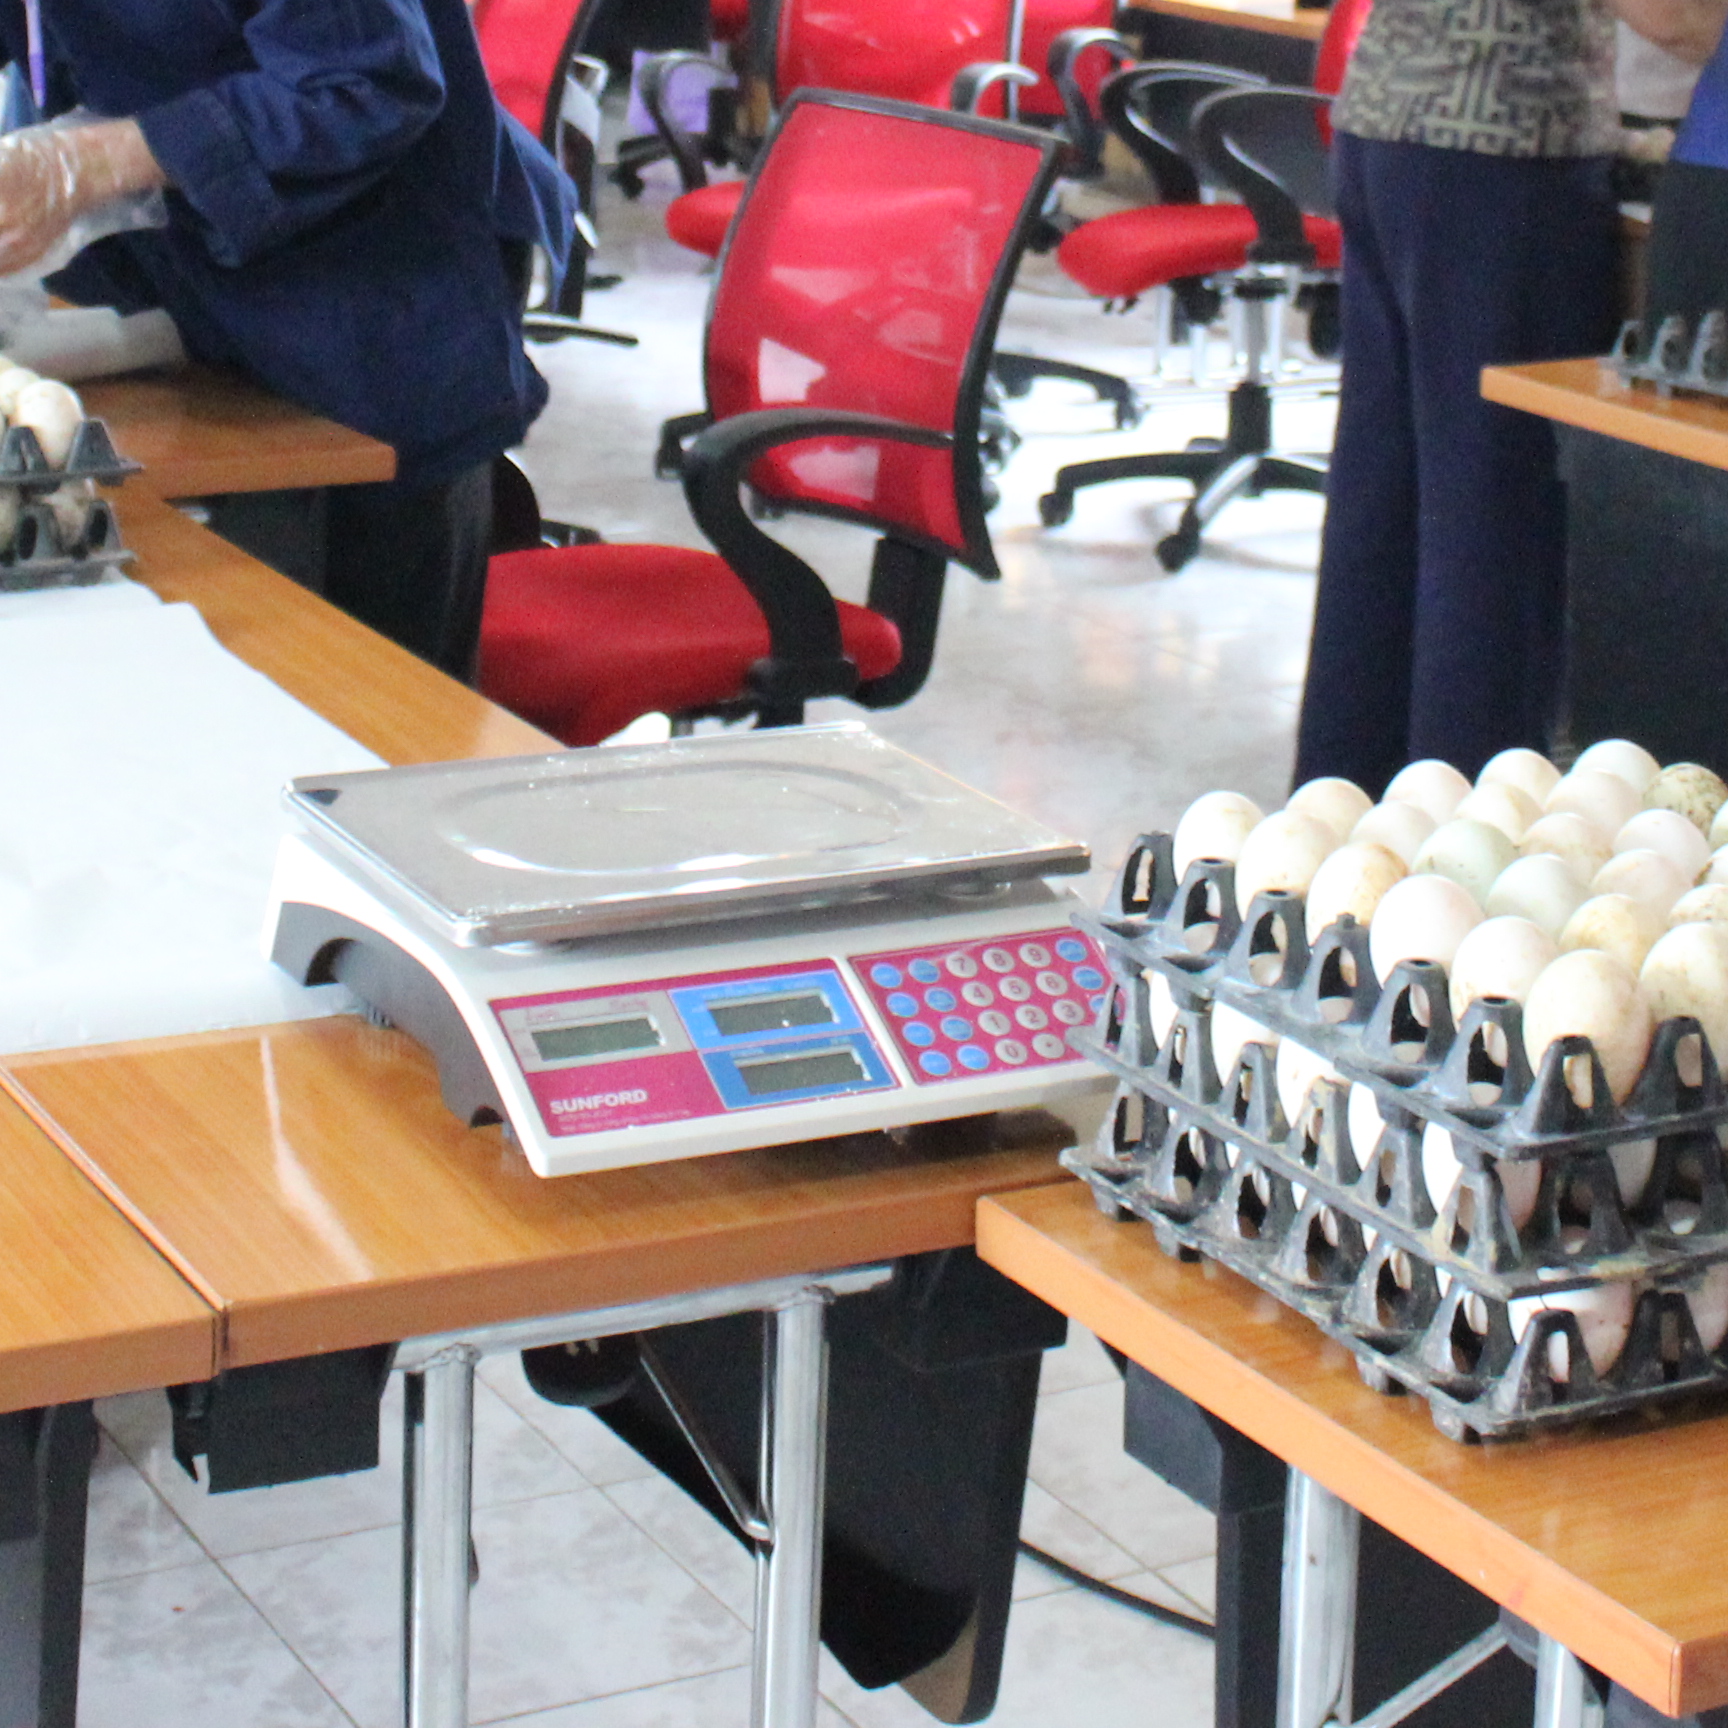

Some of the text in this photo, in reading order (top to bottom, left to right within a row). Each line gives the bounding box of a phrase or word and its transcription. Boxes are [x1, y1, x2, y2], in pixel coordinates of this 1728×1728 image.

[952, 947, 1043, 971] 7 8 9
[973, 975, 1060, 1000] 4 5 6
[988, 1004, 1077, 1029] 1 2 3
[1004, 1044, 1019, 1059] 0
[549, 1088, 648, 1116] SUNFORD
